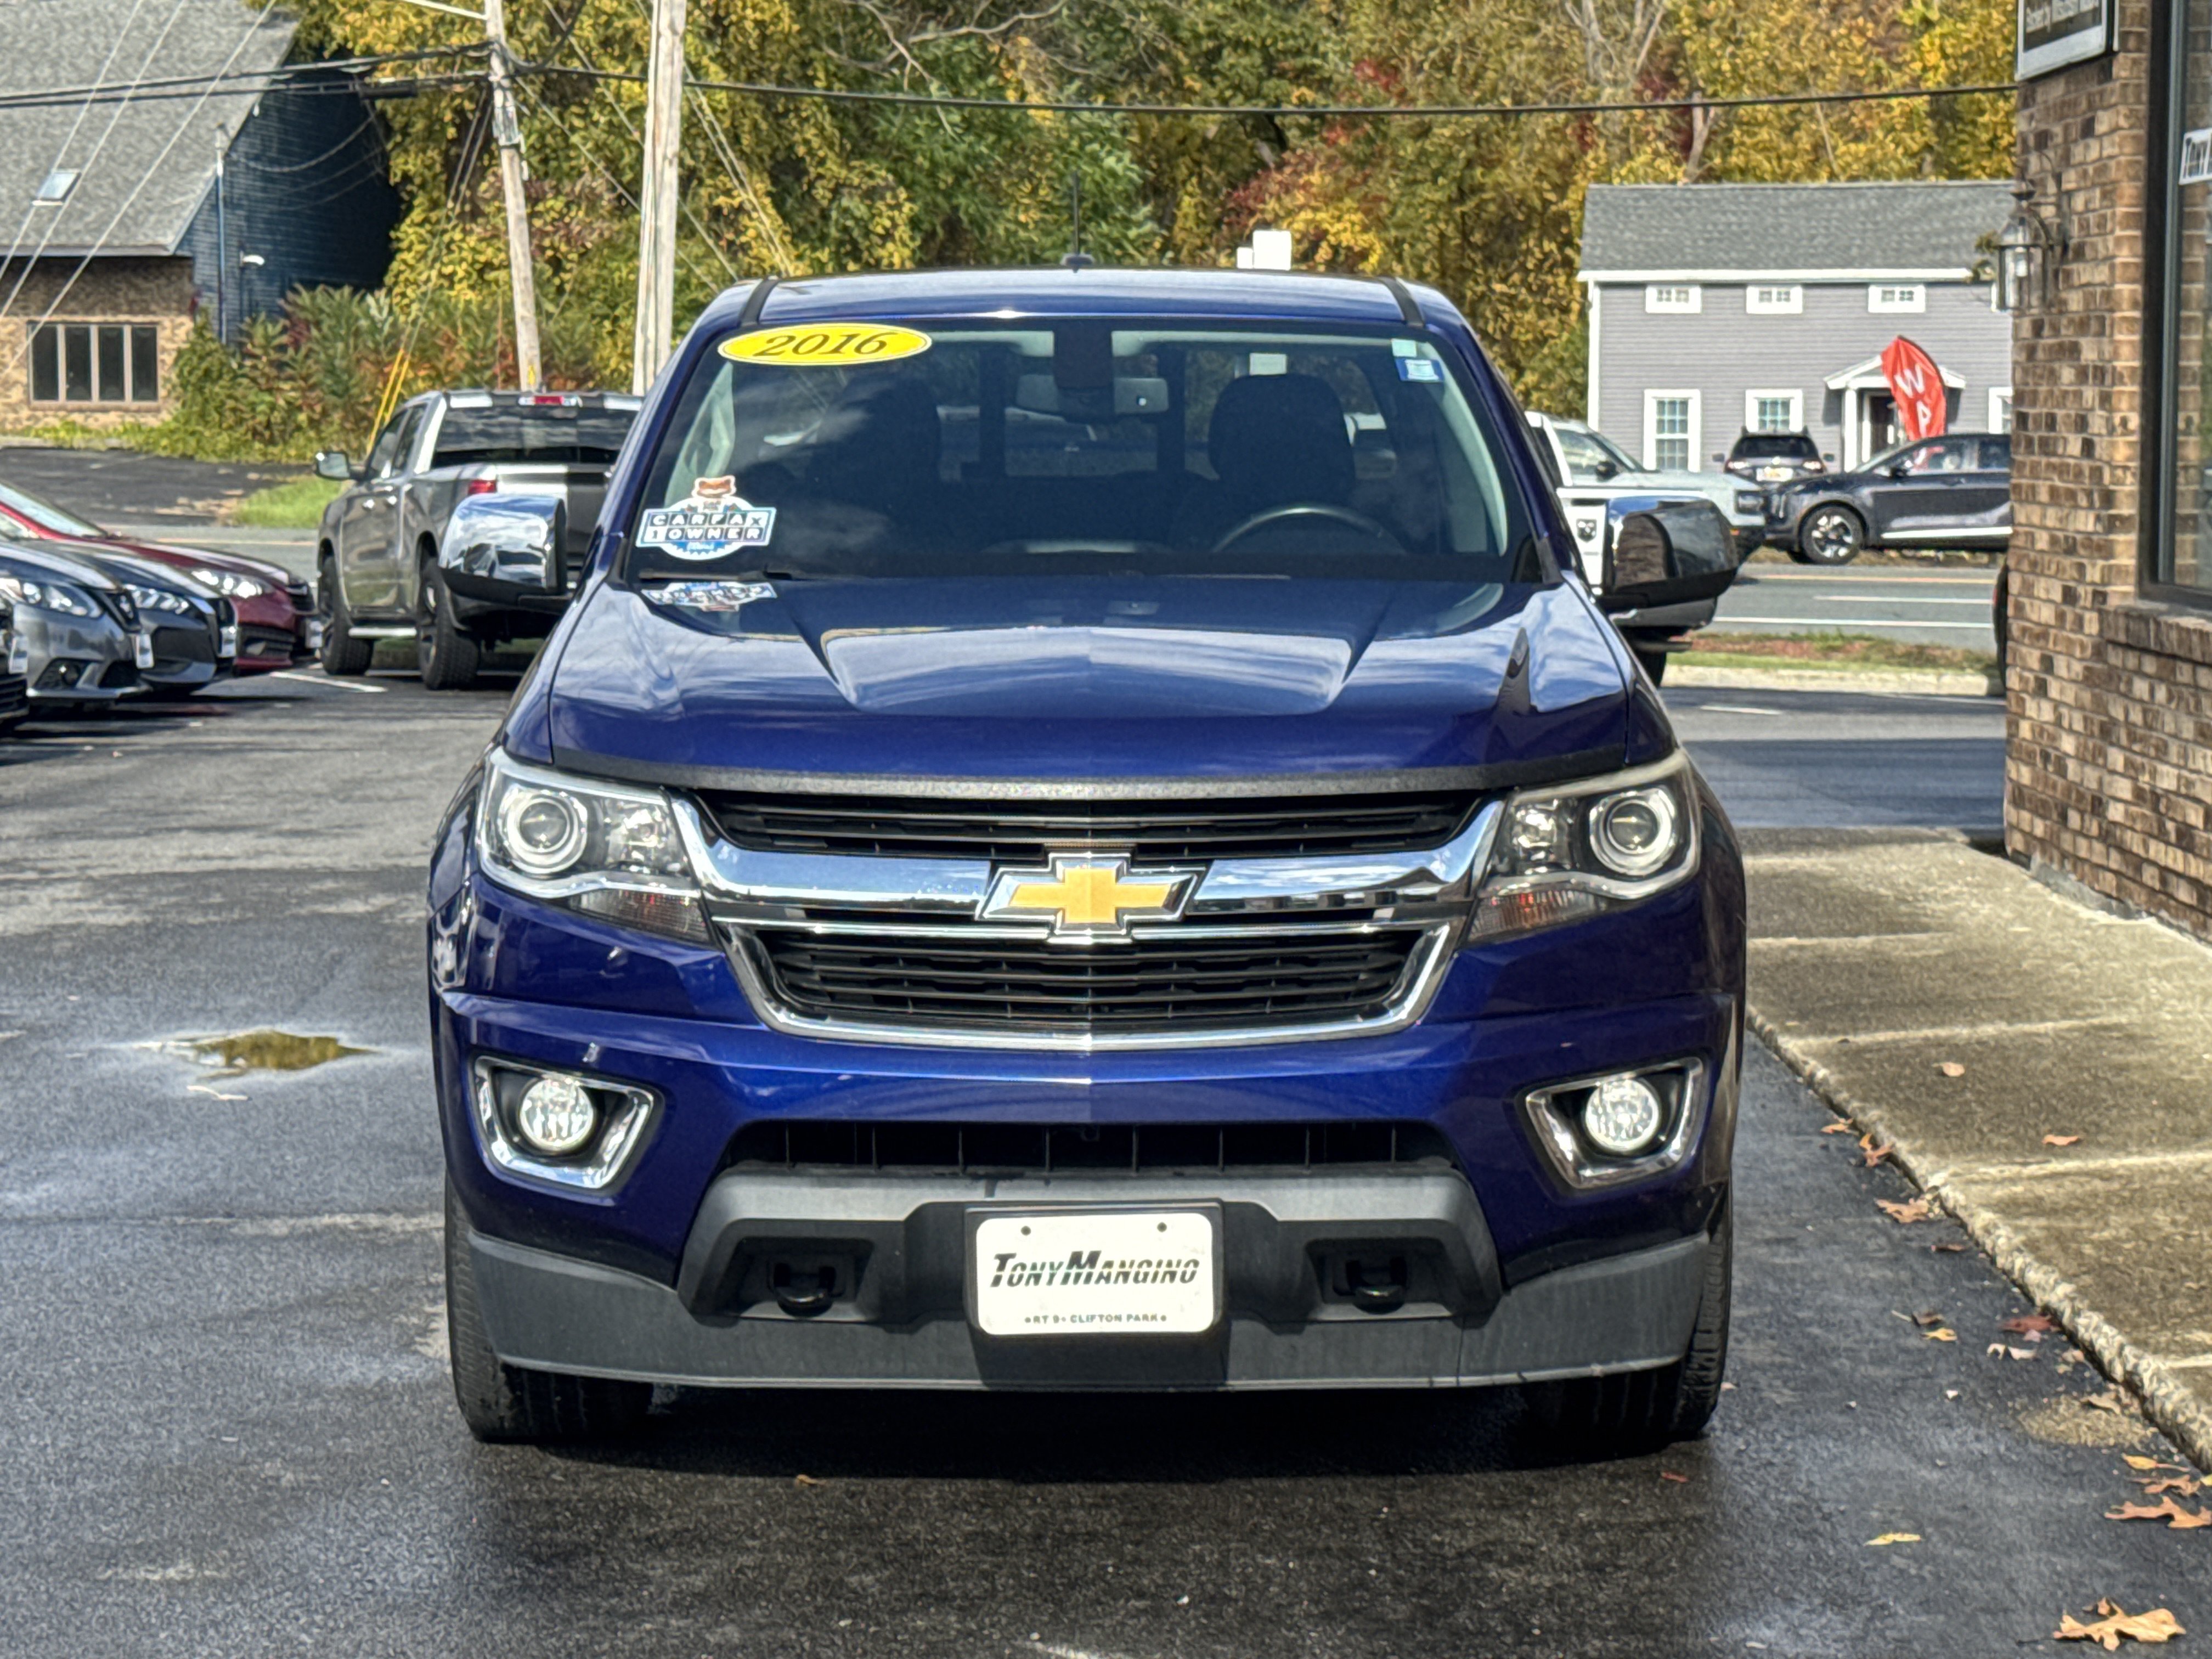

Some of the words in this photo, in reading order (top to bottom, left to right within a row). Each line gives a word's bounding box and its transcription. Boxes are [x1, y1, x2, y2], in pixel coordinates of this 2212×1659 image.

[752, 332, 898, 357] 2016
[652, 514, 763, 526] CARFAX
[1070, 1314, 1122, 1323] CLIFTON
[1126, 1314, 1158, 1322] PARK
